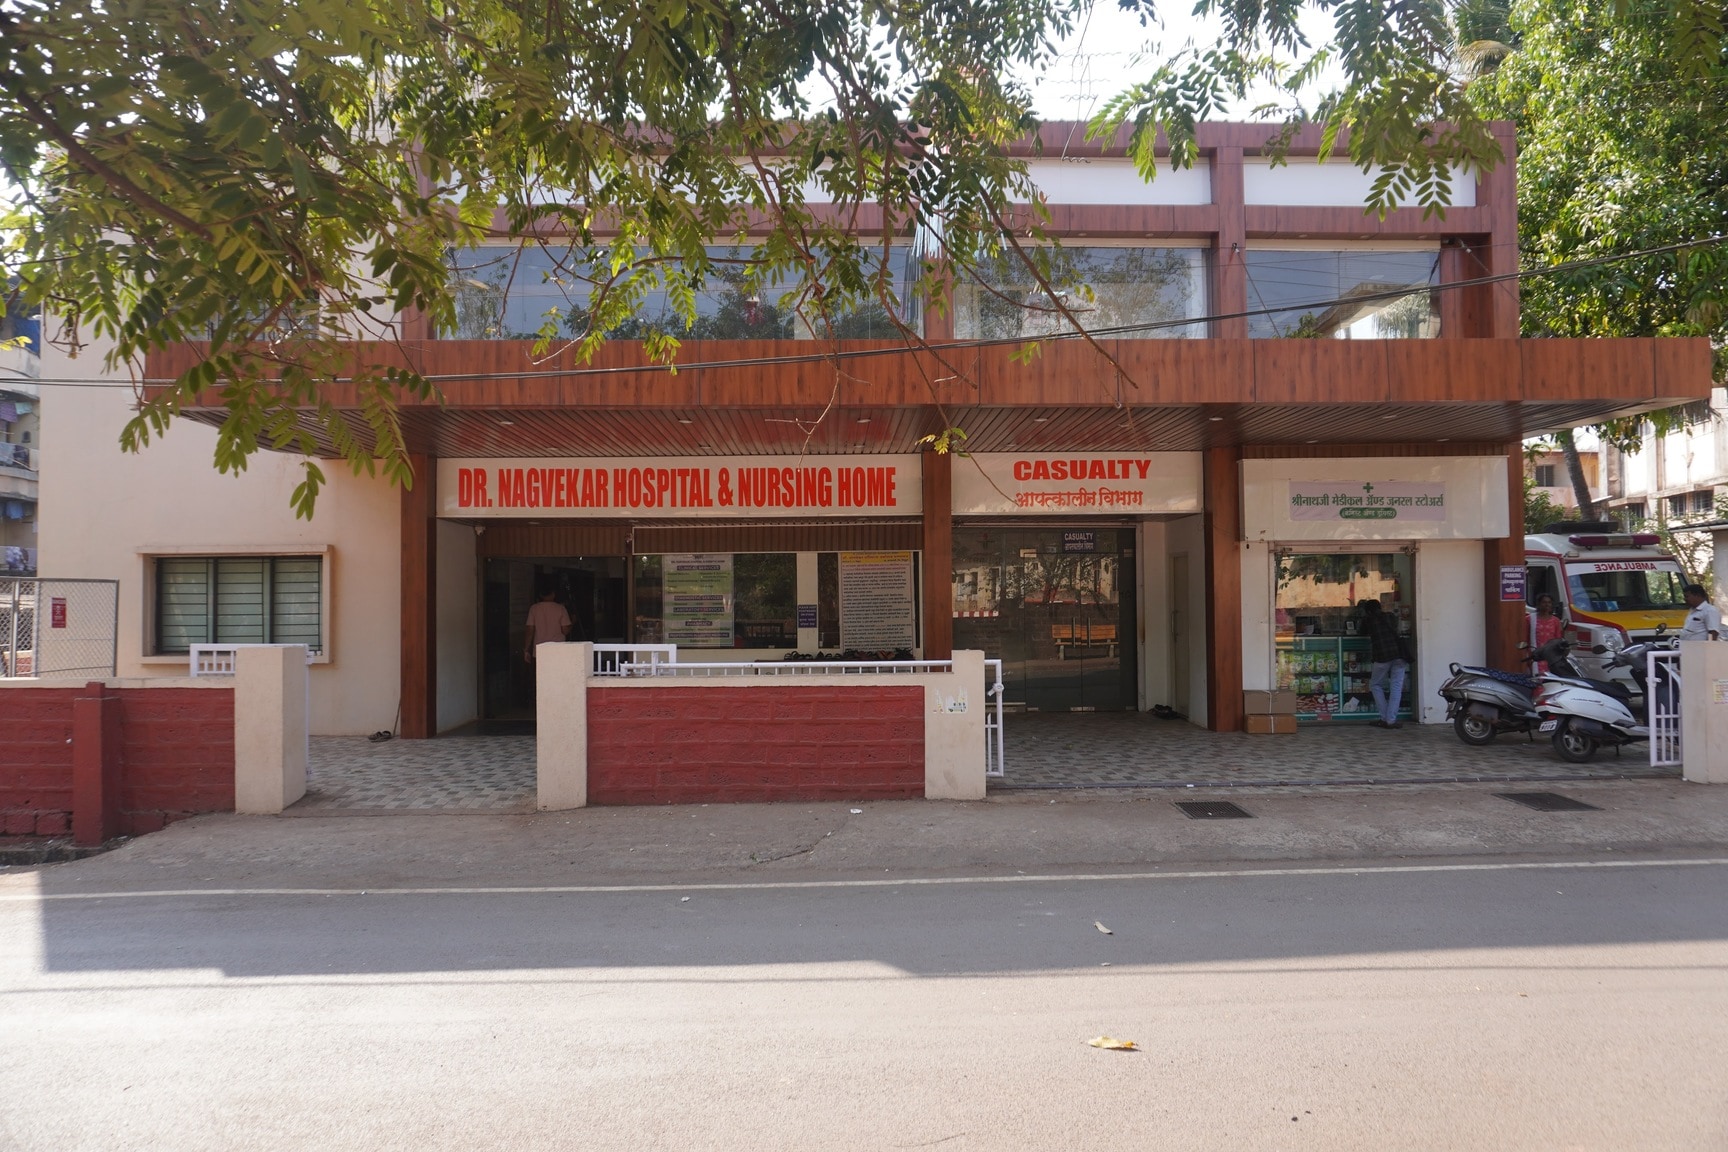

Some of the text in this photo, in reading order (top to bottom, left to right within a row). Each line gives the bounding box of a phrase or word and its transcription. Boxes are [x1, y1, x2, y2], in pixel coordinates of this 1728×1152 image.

[1014, 459, 1152, 481] CASUALTY
[458, 467, 896, 508] DR. NAGVEKAR HOSPITAL & NURSING HOME
[1016, 487, 1144, 507] आपत्कालीन विभाग
[1292, 494, 1329, 506] श्रीनाथजी
[1387, 496, 1413, 506] जनरल
[1416, 494, 1444, 506] स्टोअर्स
[1064, 532, 1094, 541] CASUALTY
